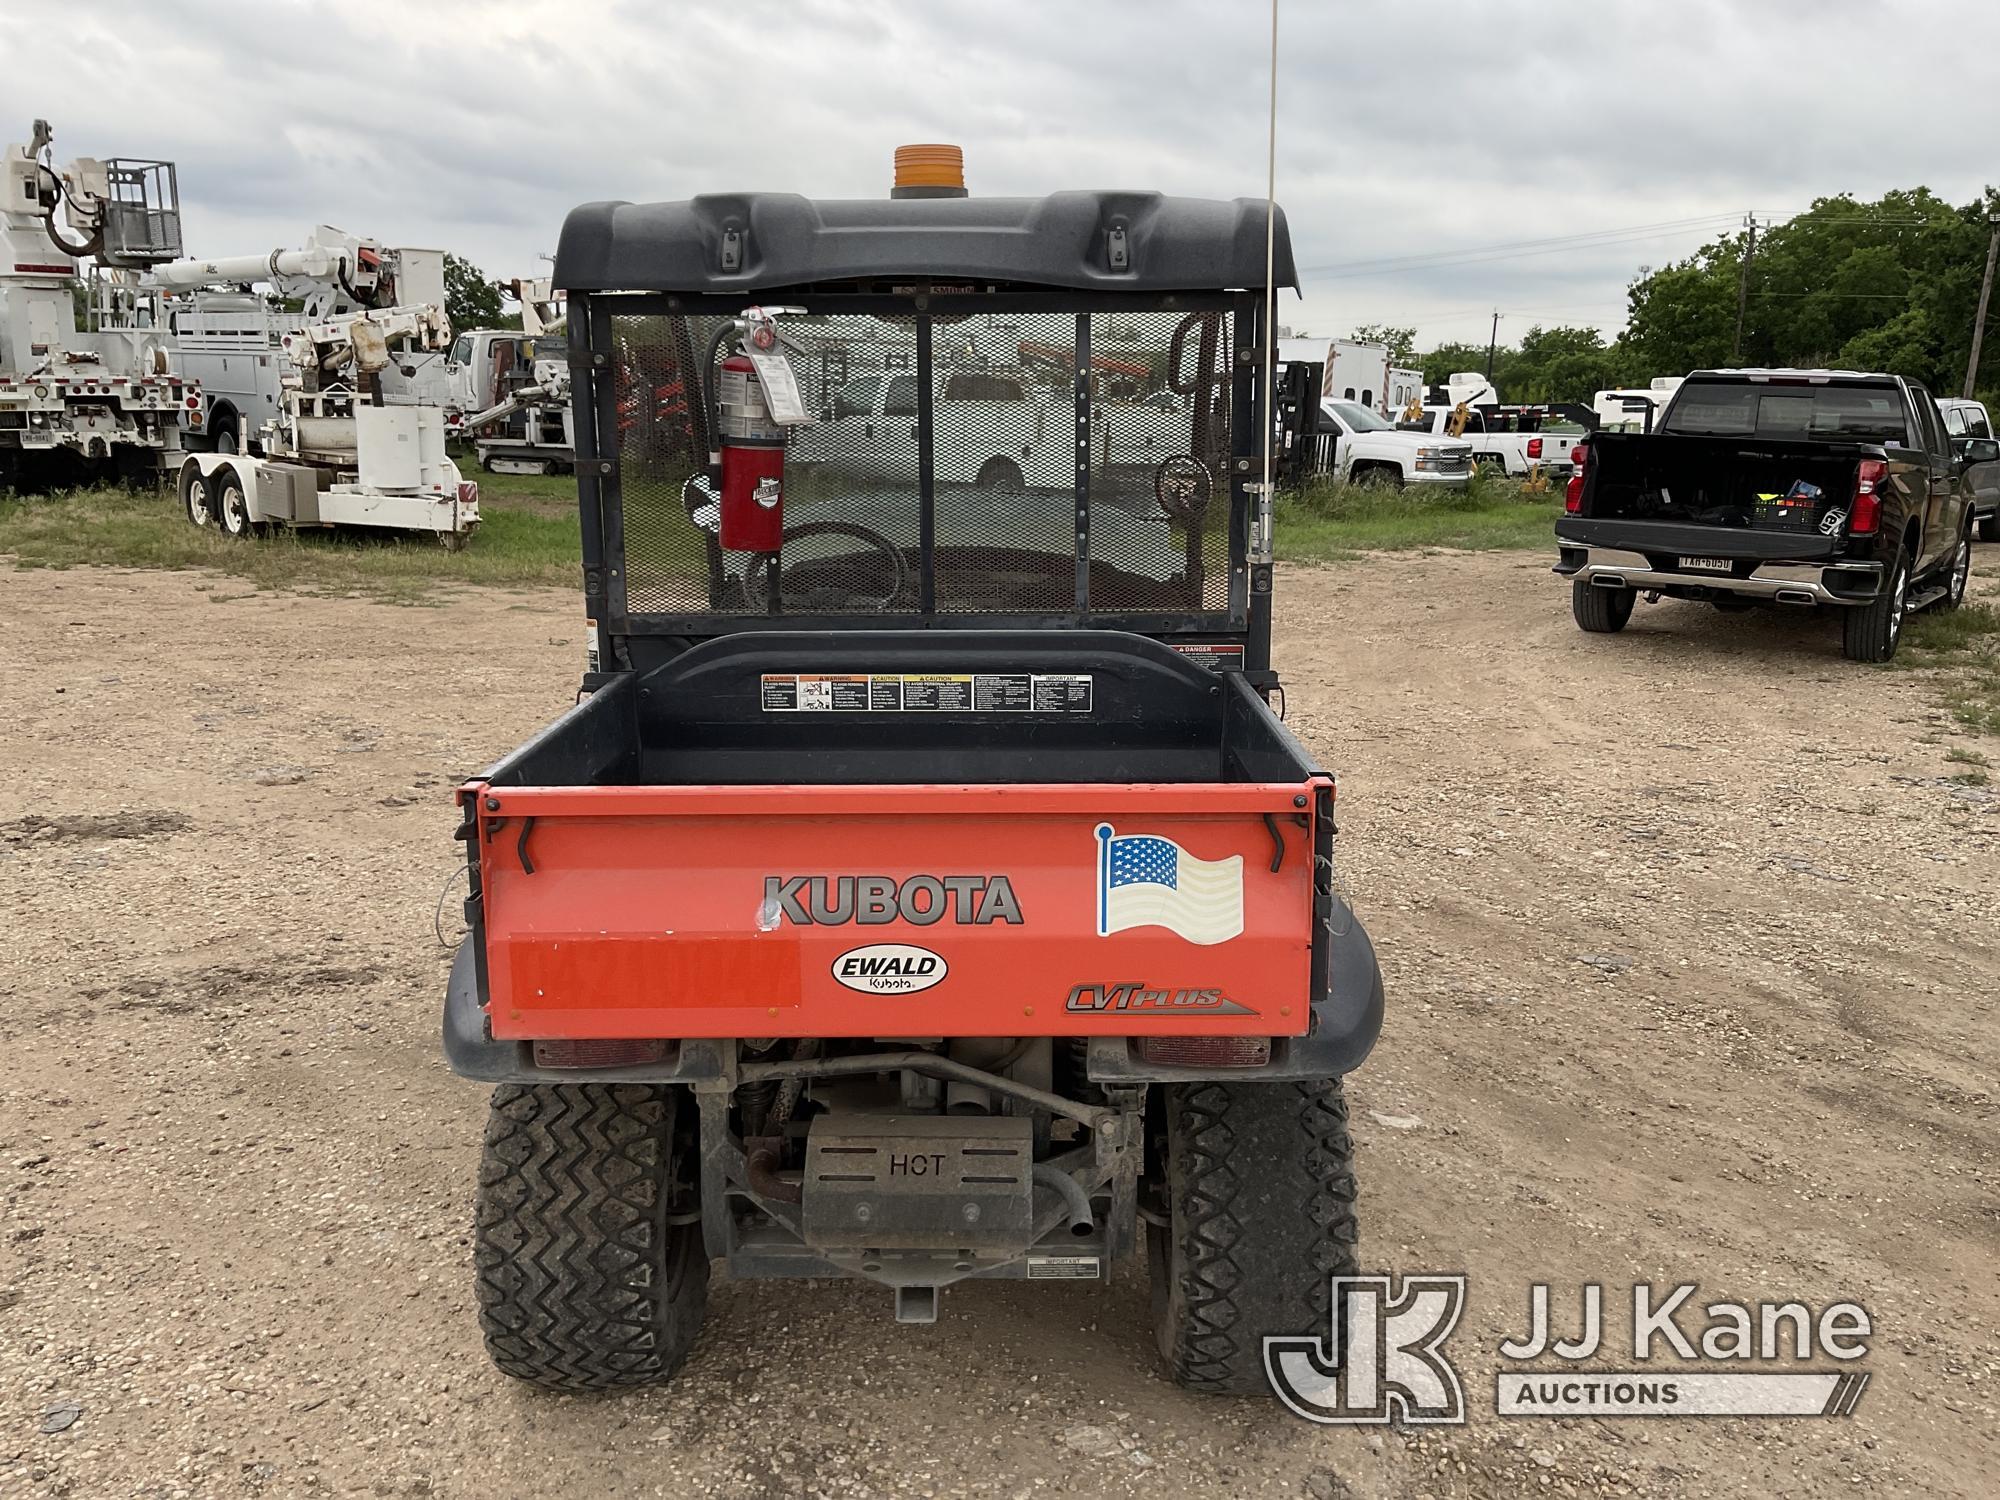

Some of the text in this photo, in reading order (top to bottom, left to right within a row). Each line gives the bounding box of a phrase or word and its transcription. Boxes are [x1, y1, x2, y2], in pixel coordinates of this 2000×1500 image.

[763, 875, 1025, 926] KUBOTA
[840, 957, 937, 975] EWALD
[890, 1154, 946, 1176] HOT
